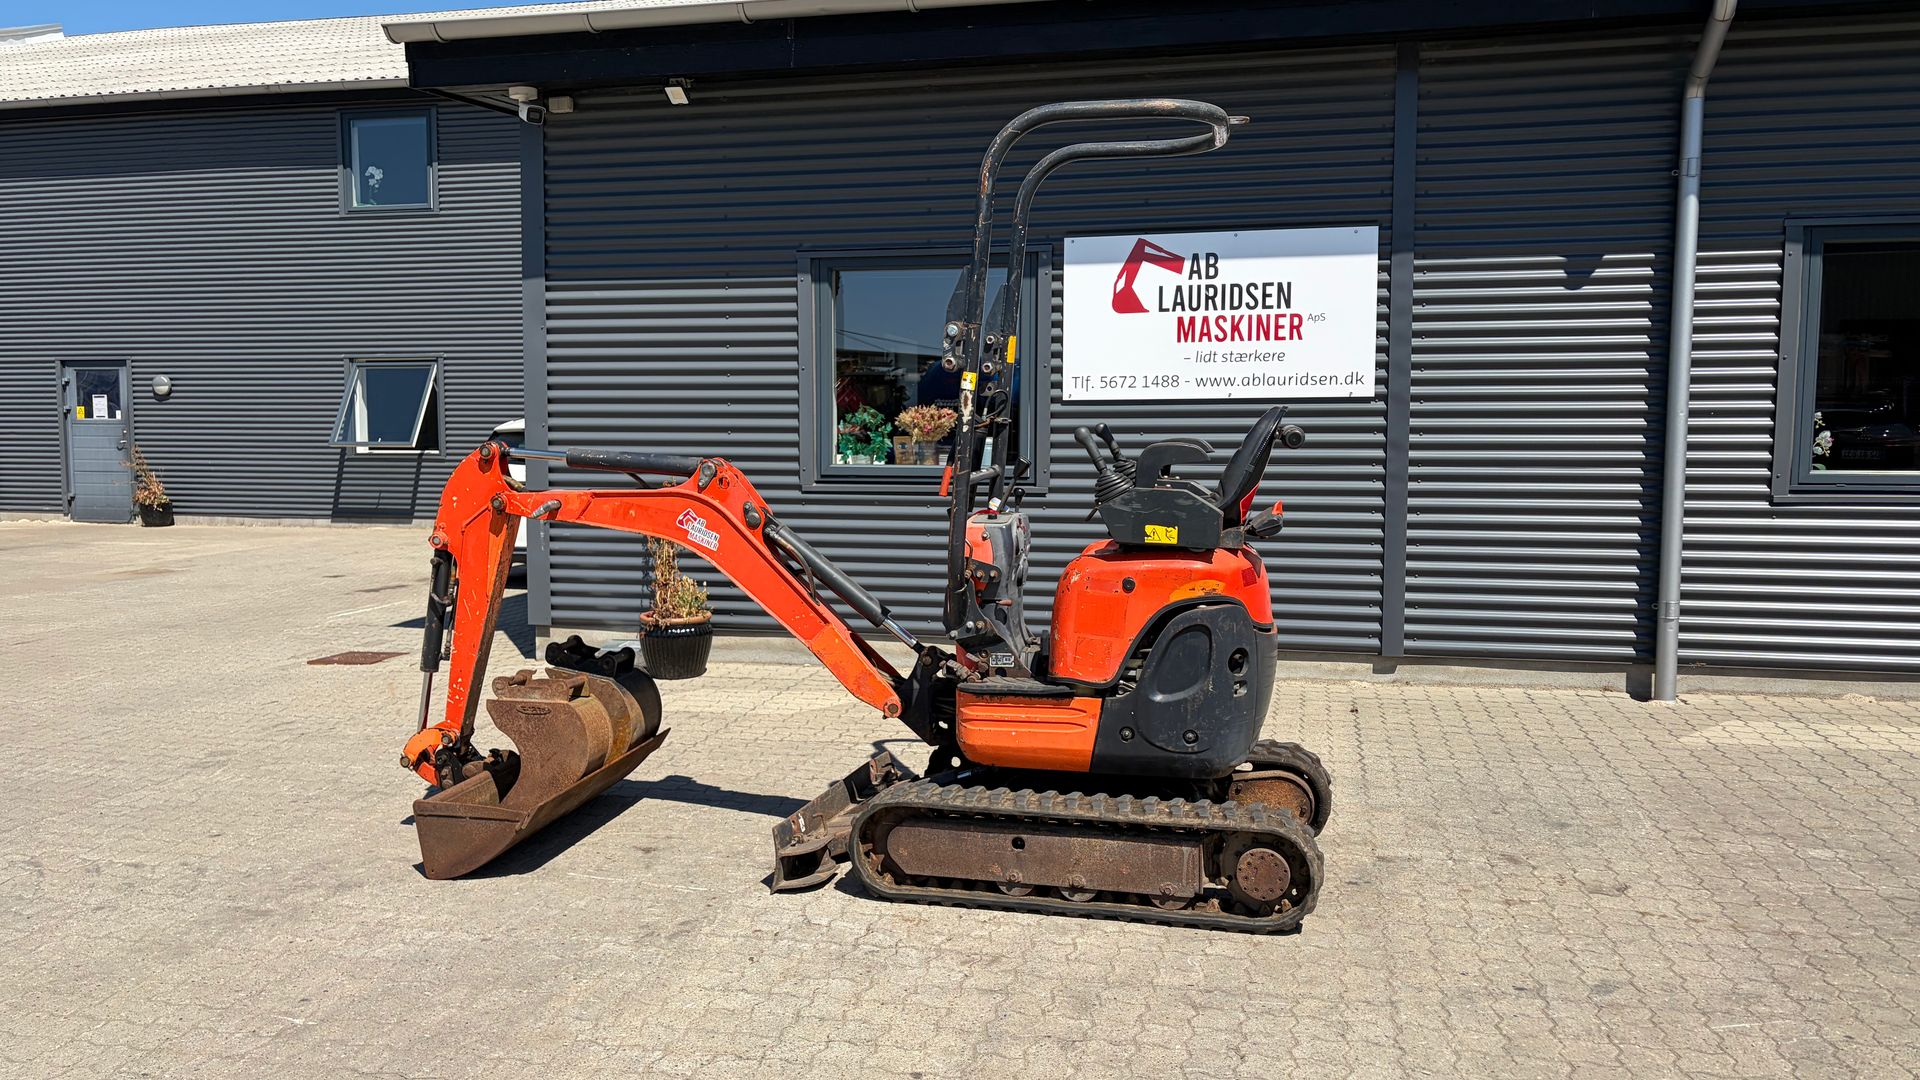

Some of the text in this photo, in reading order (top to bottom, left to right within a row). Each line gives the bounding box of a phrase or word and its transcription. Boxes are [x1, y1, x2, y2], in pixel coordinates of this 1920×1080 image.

[1188, 252, 1219, 281] AB
[1158, 281, 1292, 313] LAURIDSEN
[1176, 312, 1326, 343] MASKINER ApS
[1195, 350, 1218, 363] lidt
[1221, 349, 1286, 363] stærkere
[1072, 375, 1095, 392] Tlf.
[1099, 375, 1137, 389] 5672
[1142, 374, 1180, 388] 1488
[1195, 371, 1365, 388] www.ablauridsen.dk
[687, 522, 719, 542] LAURIDSEN
[697, 518, 706, 527] AB
[689, 531, 718, 550] MASKINER
